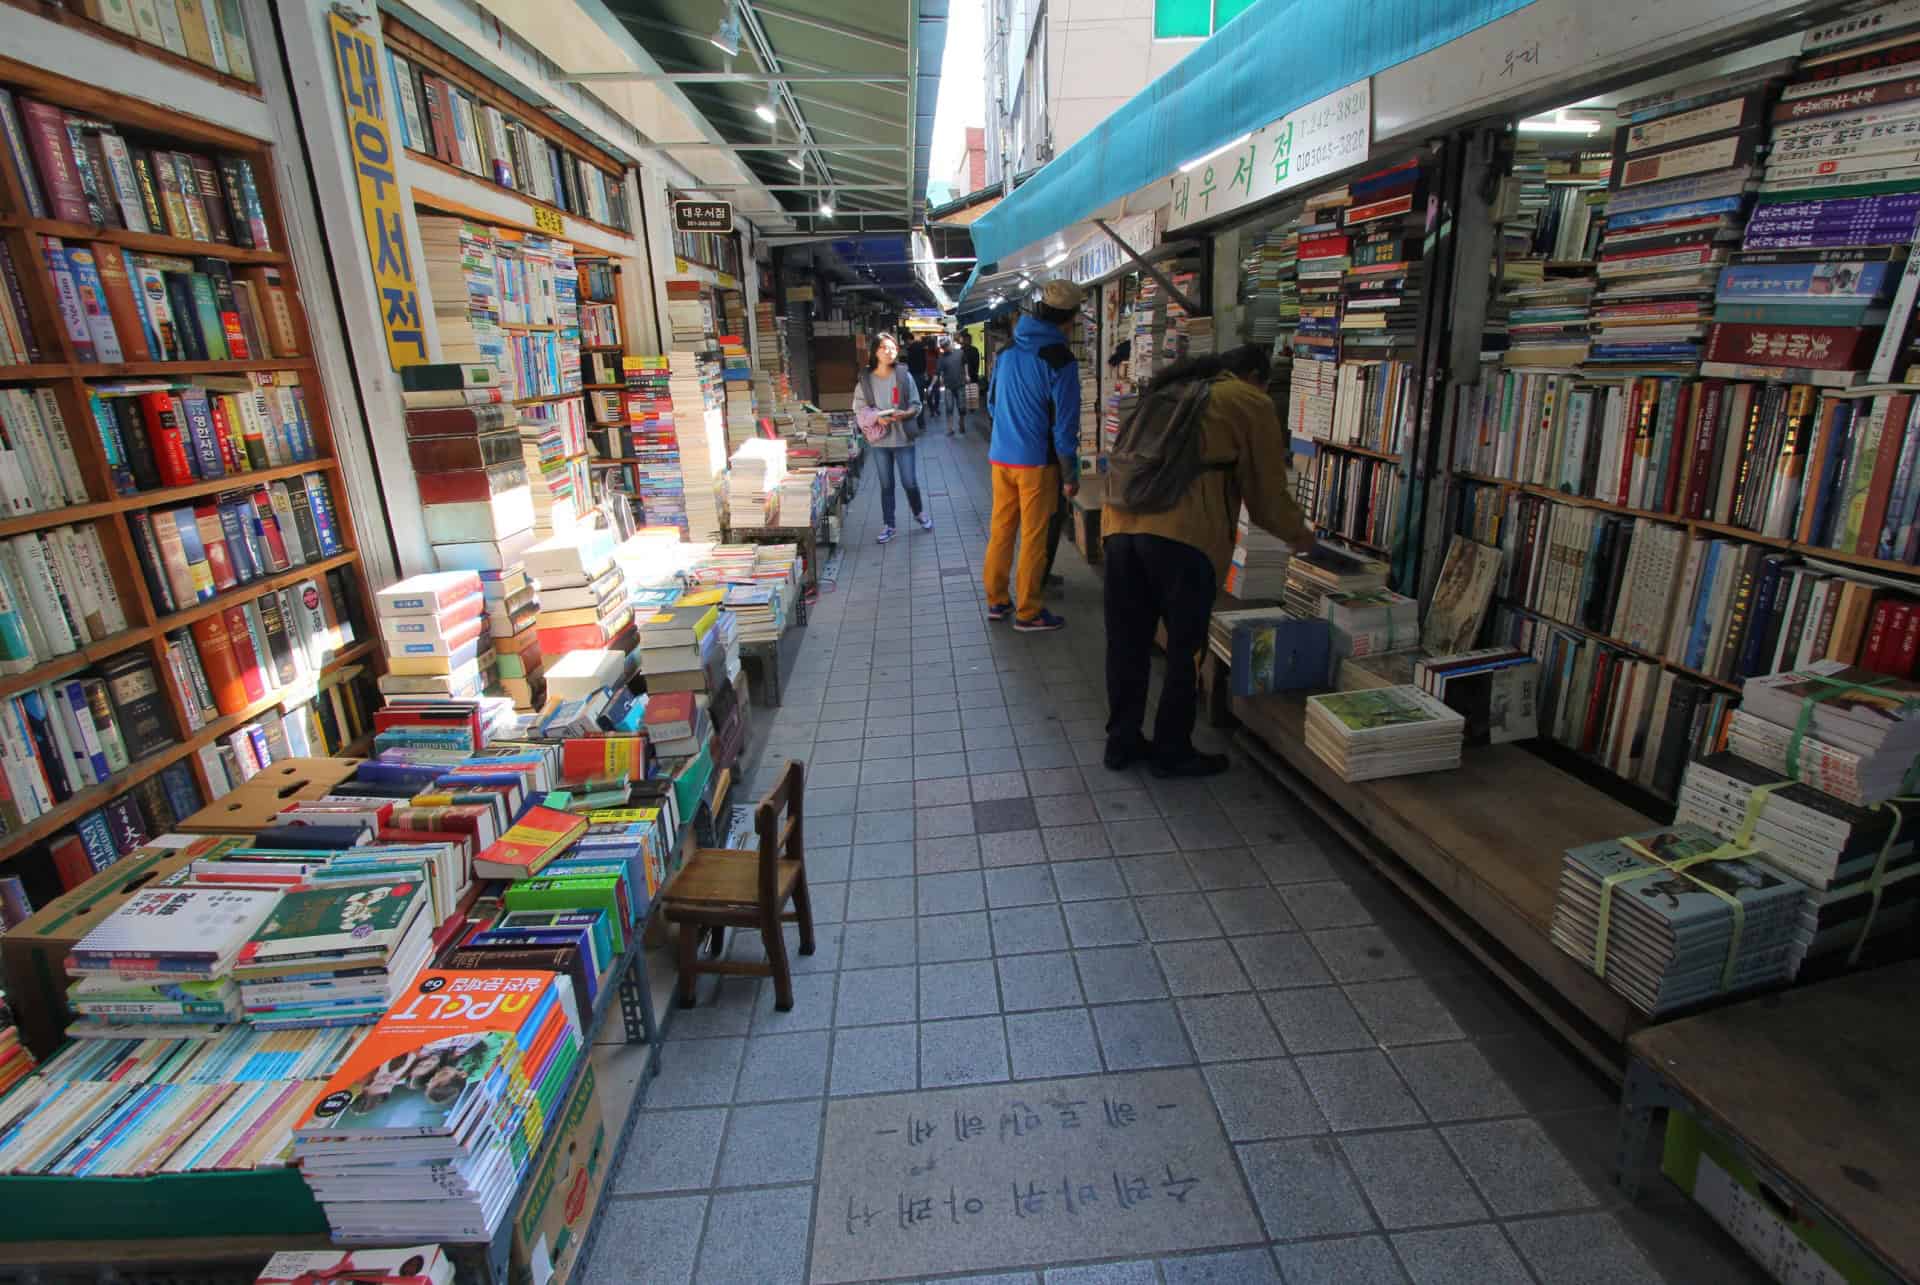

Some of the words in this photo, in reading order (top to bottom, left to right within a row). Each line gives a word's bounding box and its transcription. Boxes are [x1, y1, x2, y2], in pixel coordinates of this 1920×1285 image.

[337, 31, 426, 360] 대우서적
[1174, 121, 1293, 220] 대우서점
[682, 207, 725, 219] 대우서점
[447, 977, 504, 993] 문제집
[847, 1183, 984, 1235] 아래서
[1012, 1163, 1200, 1219] 수레바퀴
